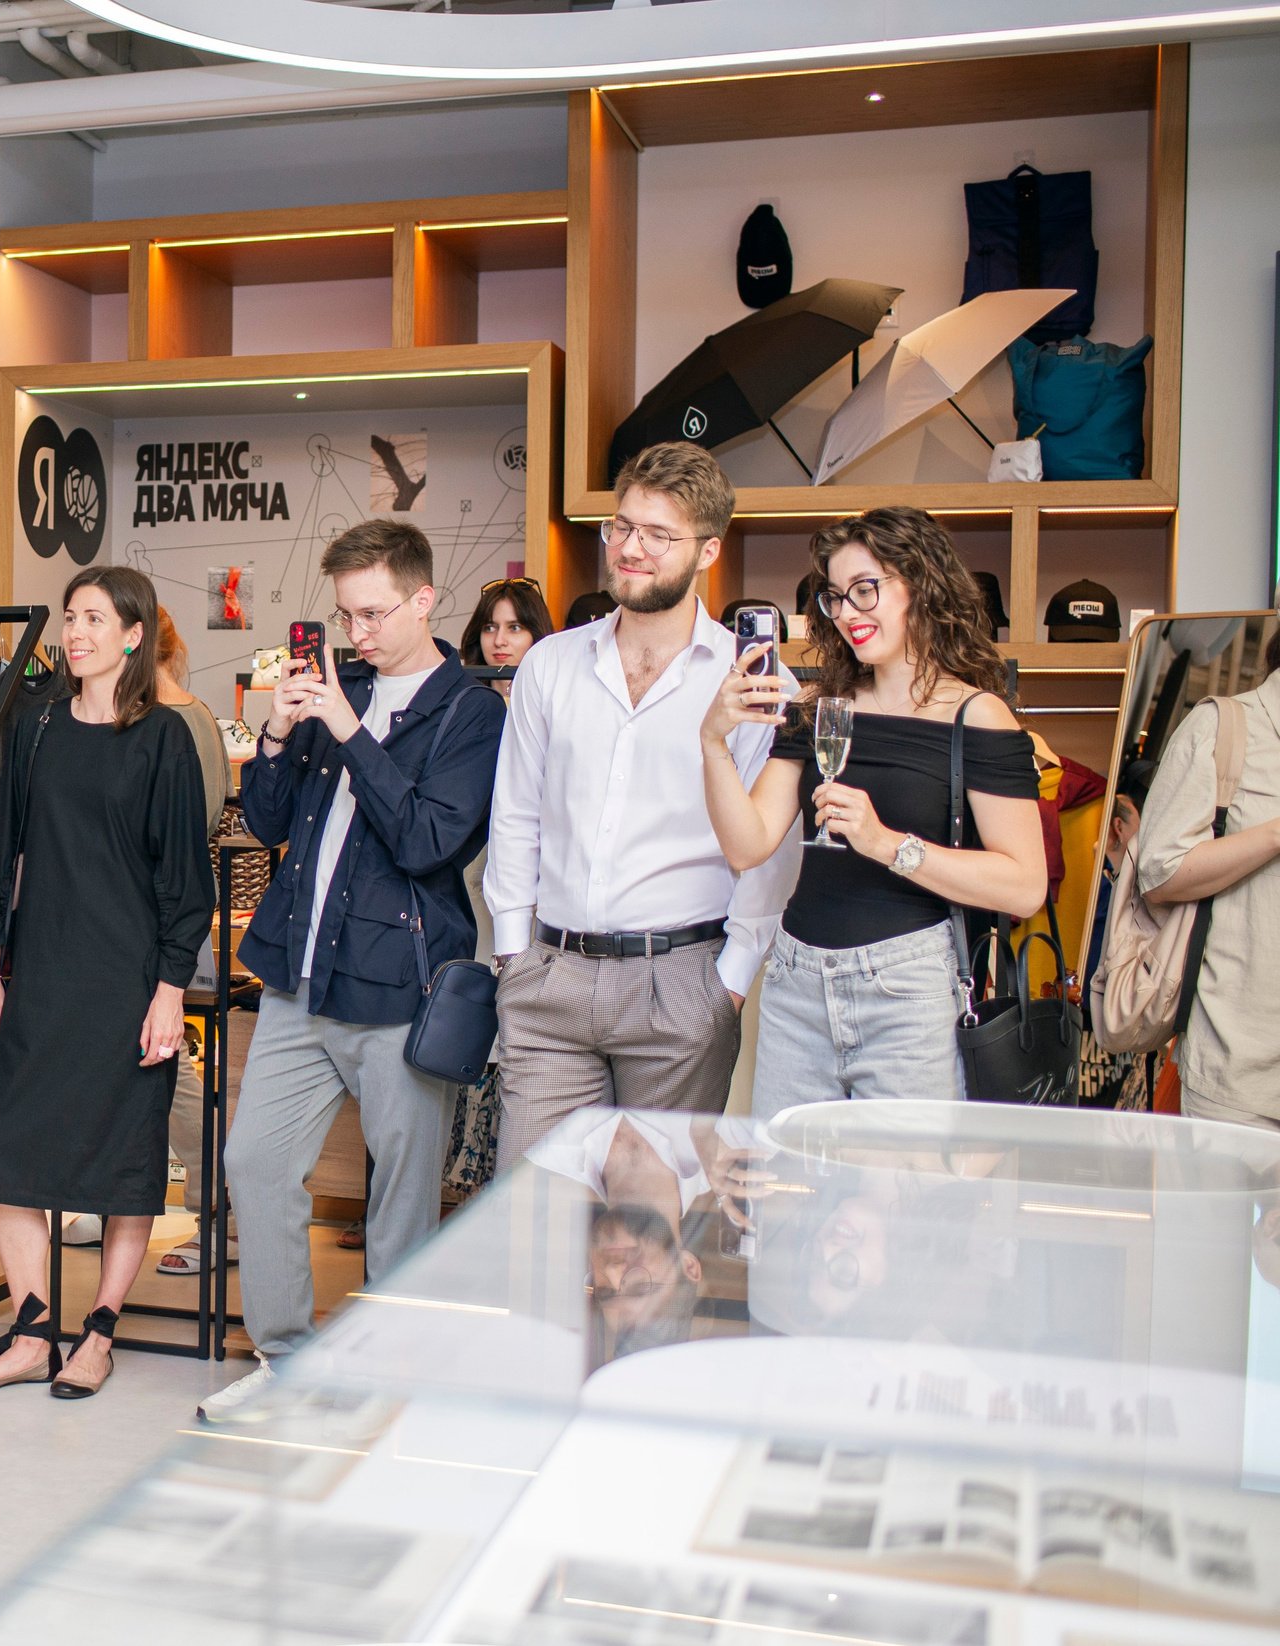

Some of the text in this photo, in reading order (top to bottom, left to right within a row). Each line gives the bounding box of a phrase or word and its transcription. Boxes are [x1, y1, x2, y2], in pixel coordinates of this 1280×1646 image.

[135, 441, 250, 485] ЯНДЕКС
[32, 446, 55, 530] Я
[133, 482, 290, 528] ДВА МЯЧА
[1073, 604, 1100, 612] MEOW
